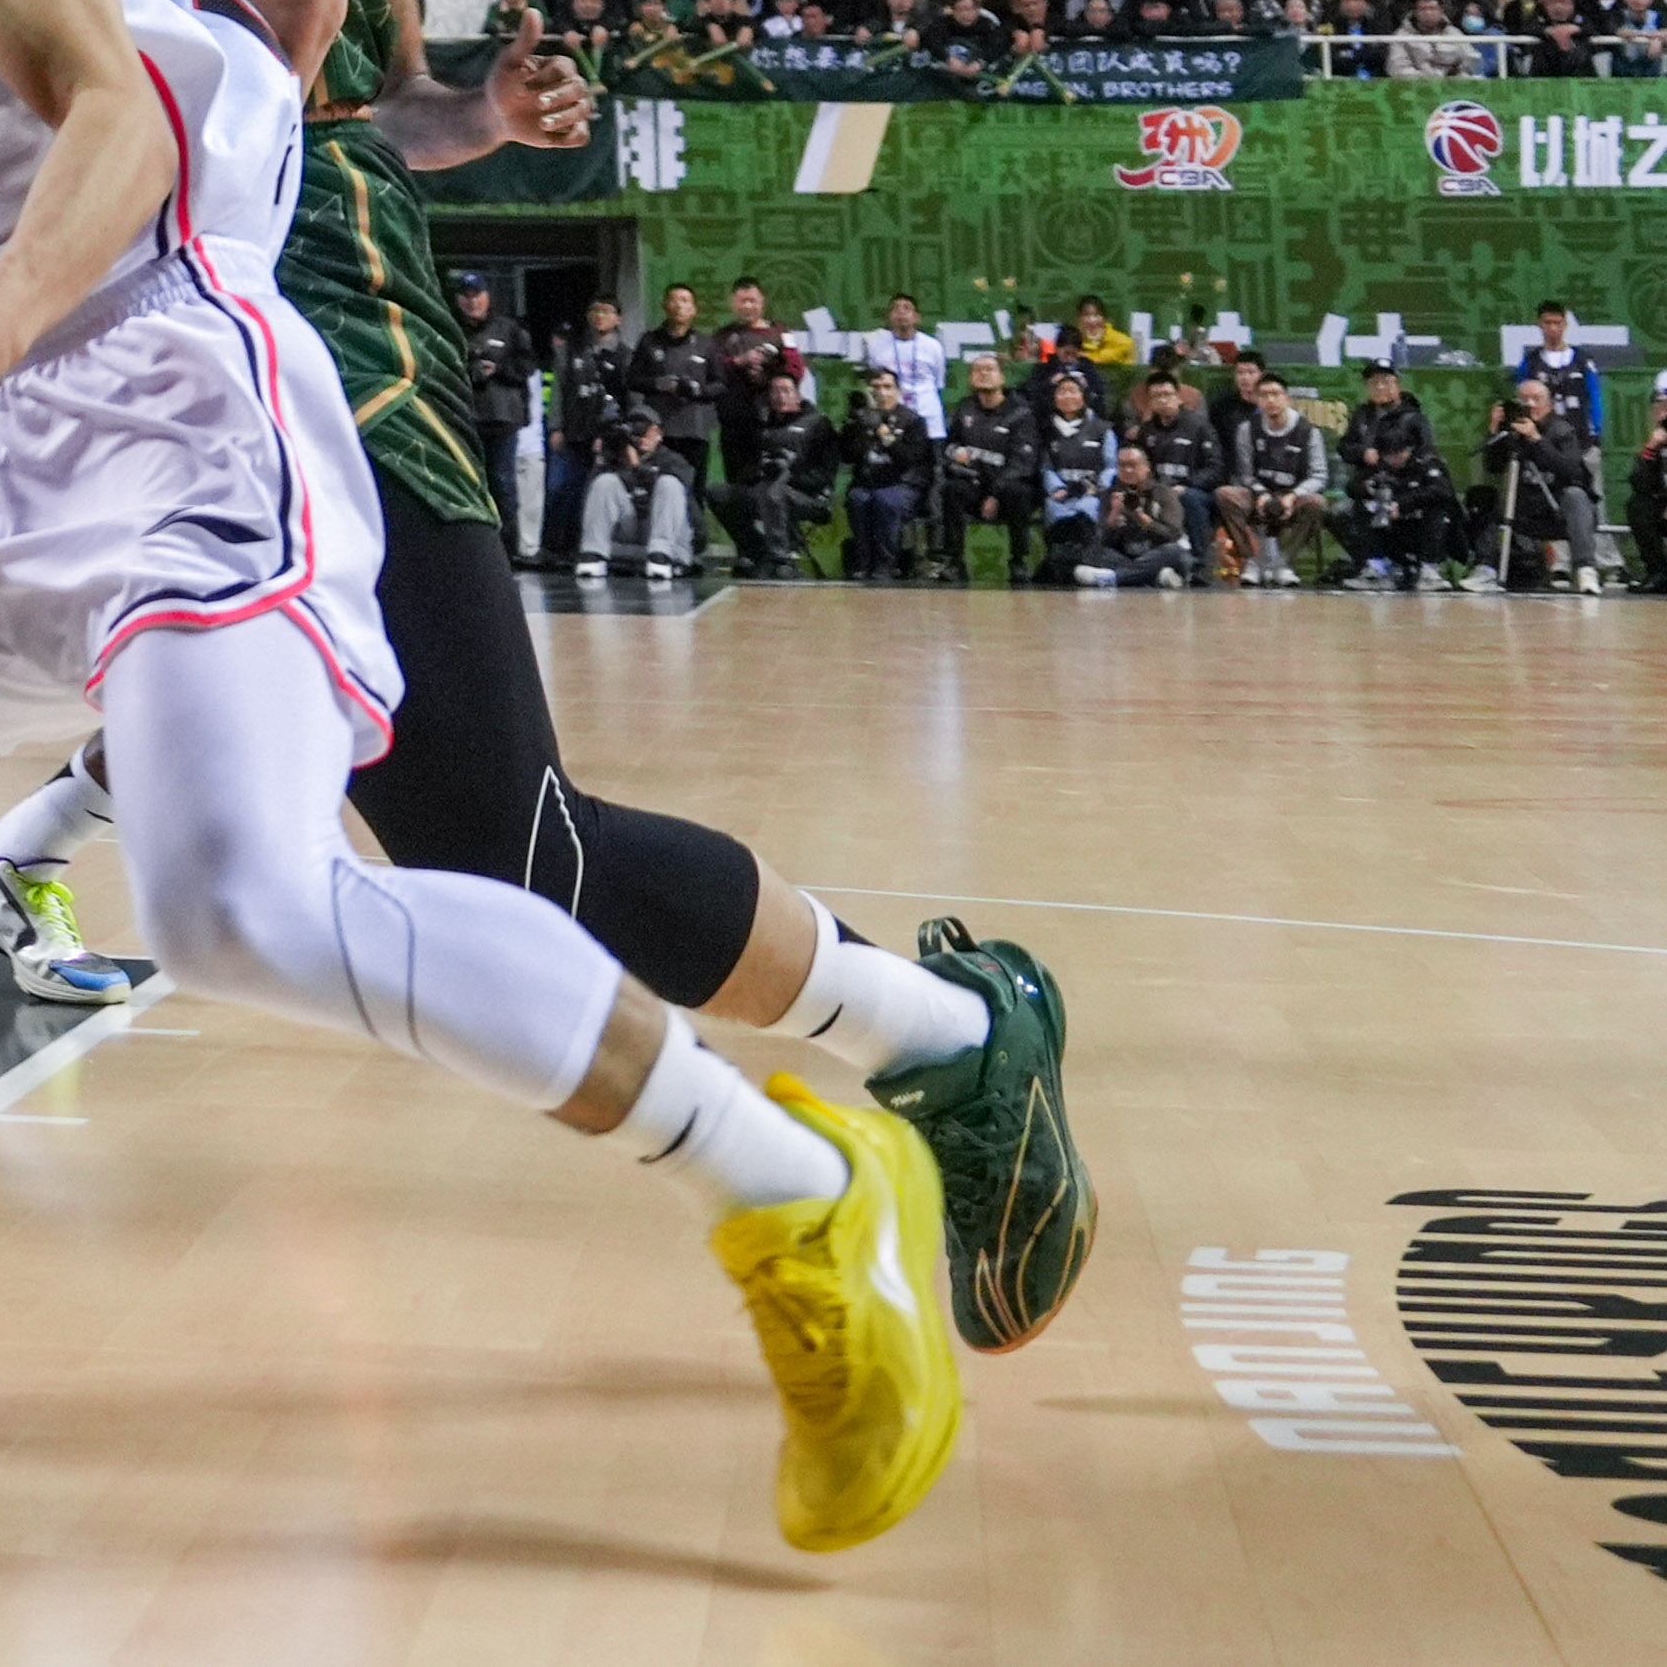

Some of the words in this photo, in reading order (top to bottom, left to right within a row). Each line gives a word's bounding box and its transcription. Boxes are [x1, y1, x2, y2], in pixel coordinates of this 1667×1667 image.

[977, 80, 1049, 98] CME
[1102, 80, 1234, 99] BROTHERS
[1157, 168, 1235, 191] CBA
[1179, 1245, 1467, 1457] NANJING
